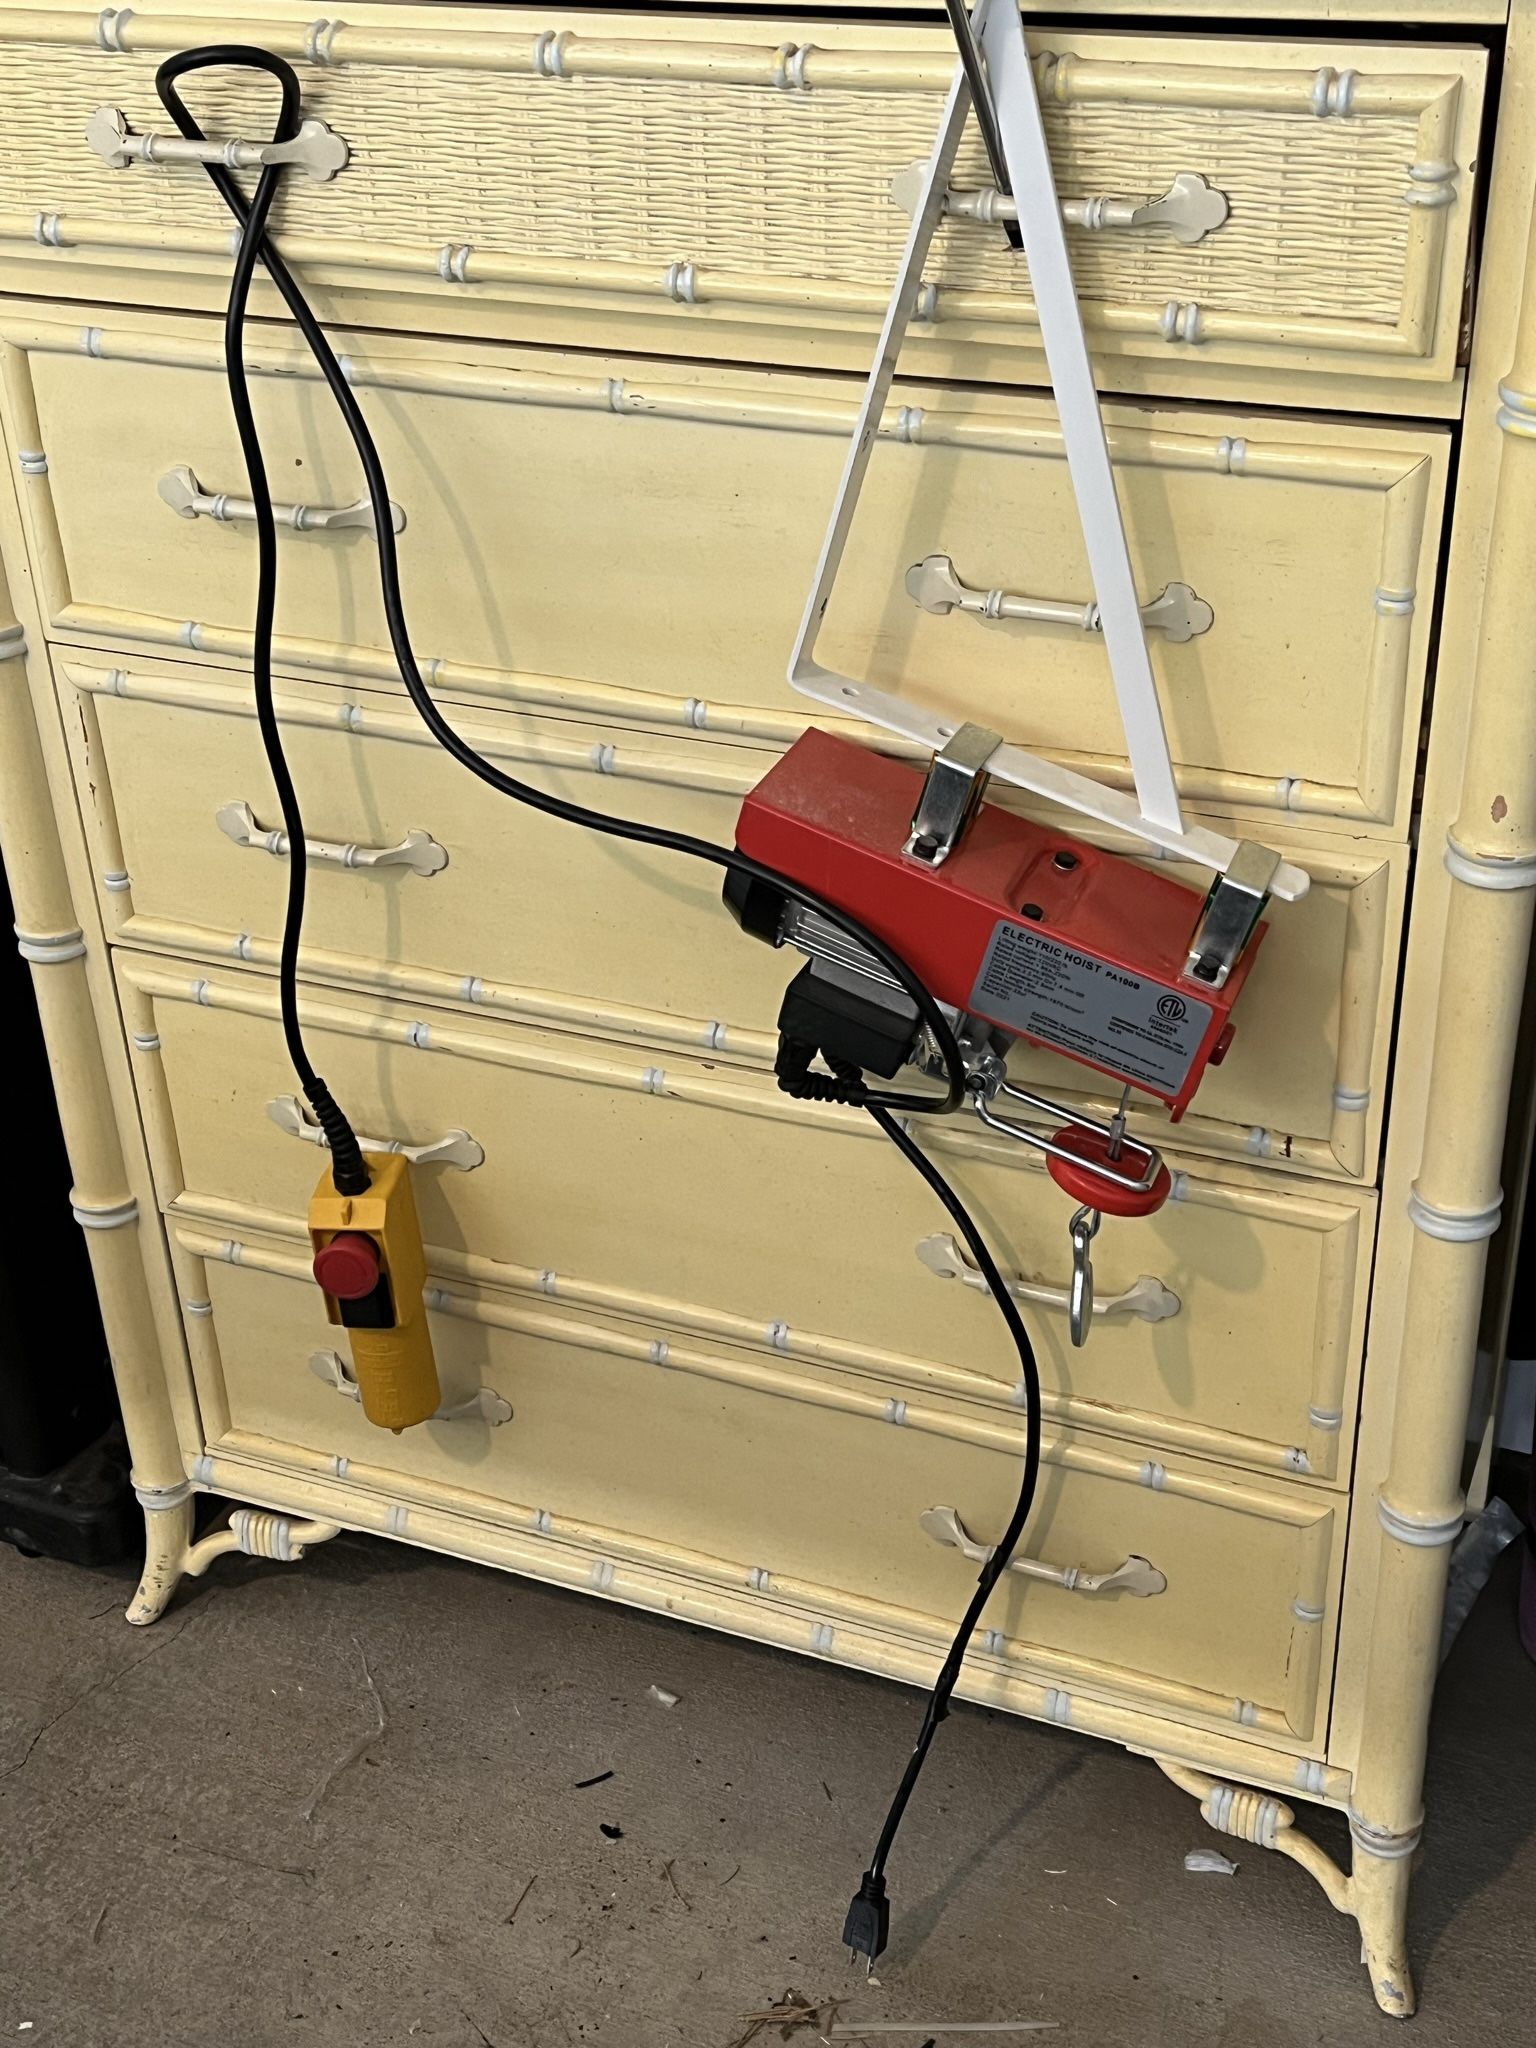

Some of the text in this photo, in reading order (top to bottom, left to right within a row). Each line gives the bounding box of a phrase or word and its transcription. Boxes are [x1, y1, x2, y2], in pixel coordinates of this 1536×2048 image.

[1001, 926, 1062, 956] ELECTRIC
[1064, 952, 1102, 974] HOIST
[1148, 1016, 1178, 1034] Intertek
